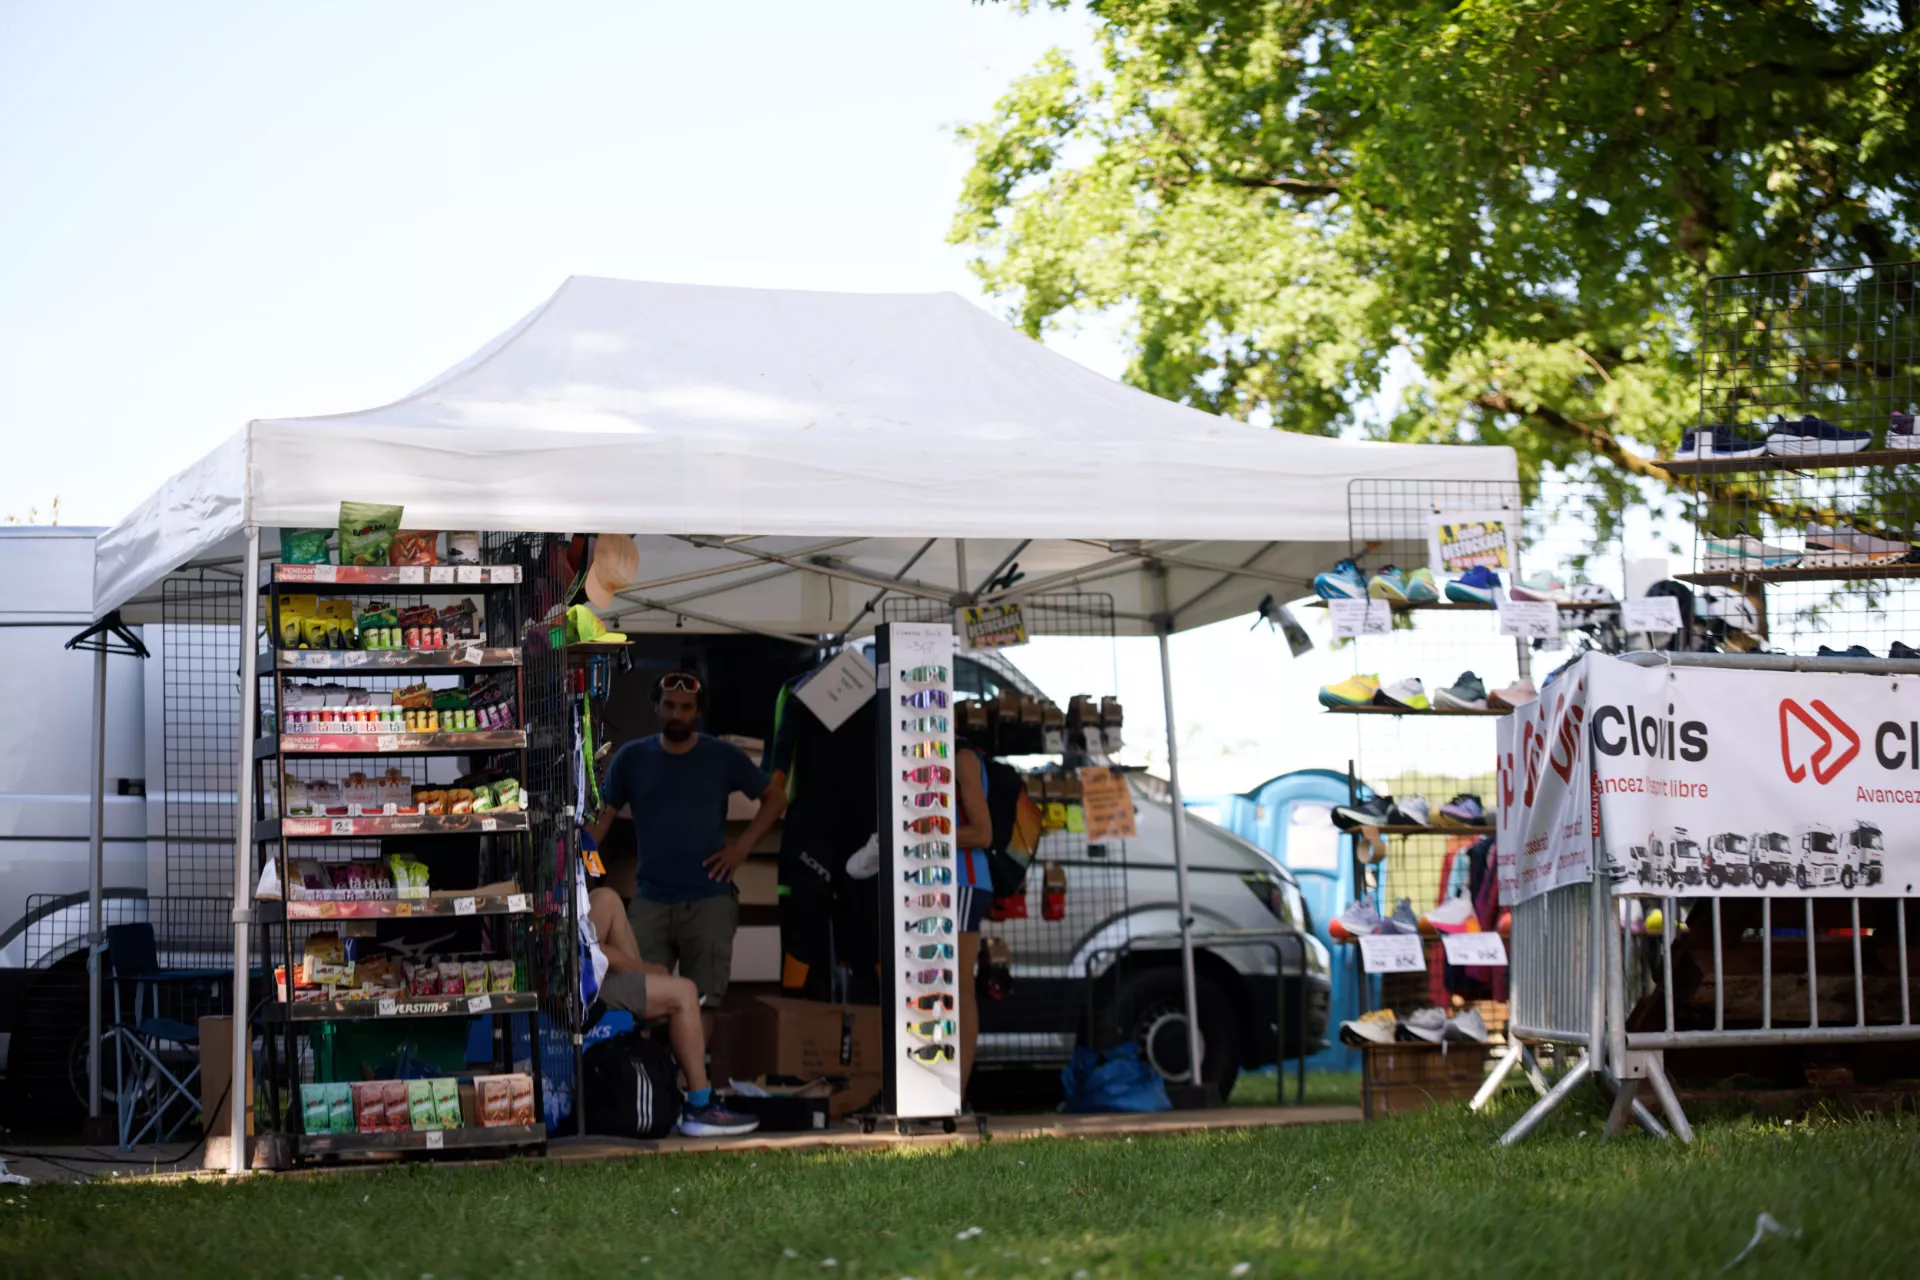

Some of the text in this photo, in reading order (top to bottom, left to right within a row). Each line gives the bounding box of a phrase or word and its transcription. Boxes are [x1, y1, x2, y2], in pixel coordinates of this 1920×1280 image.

[1592, 703, 1709, 763] Clovis
[1669, 779, 1709, 799] libre
[1856, 785, 1920, 804] Avancez
